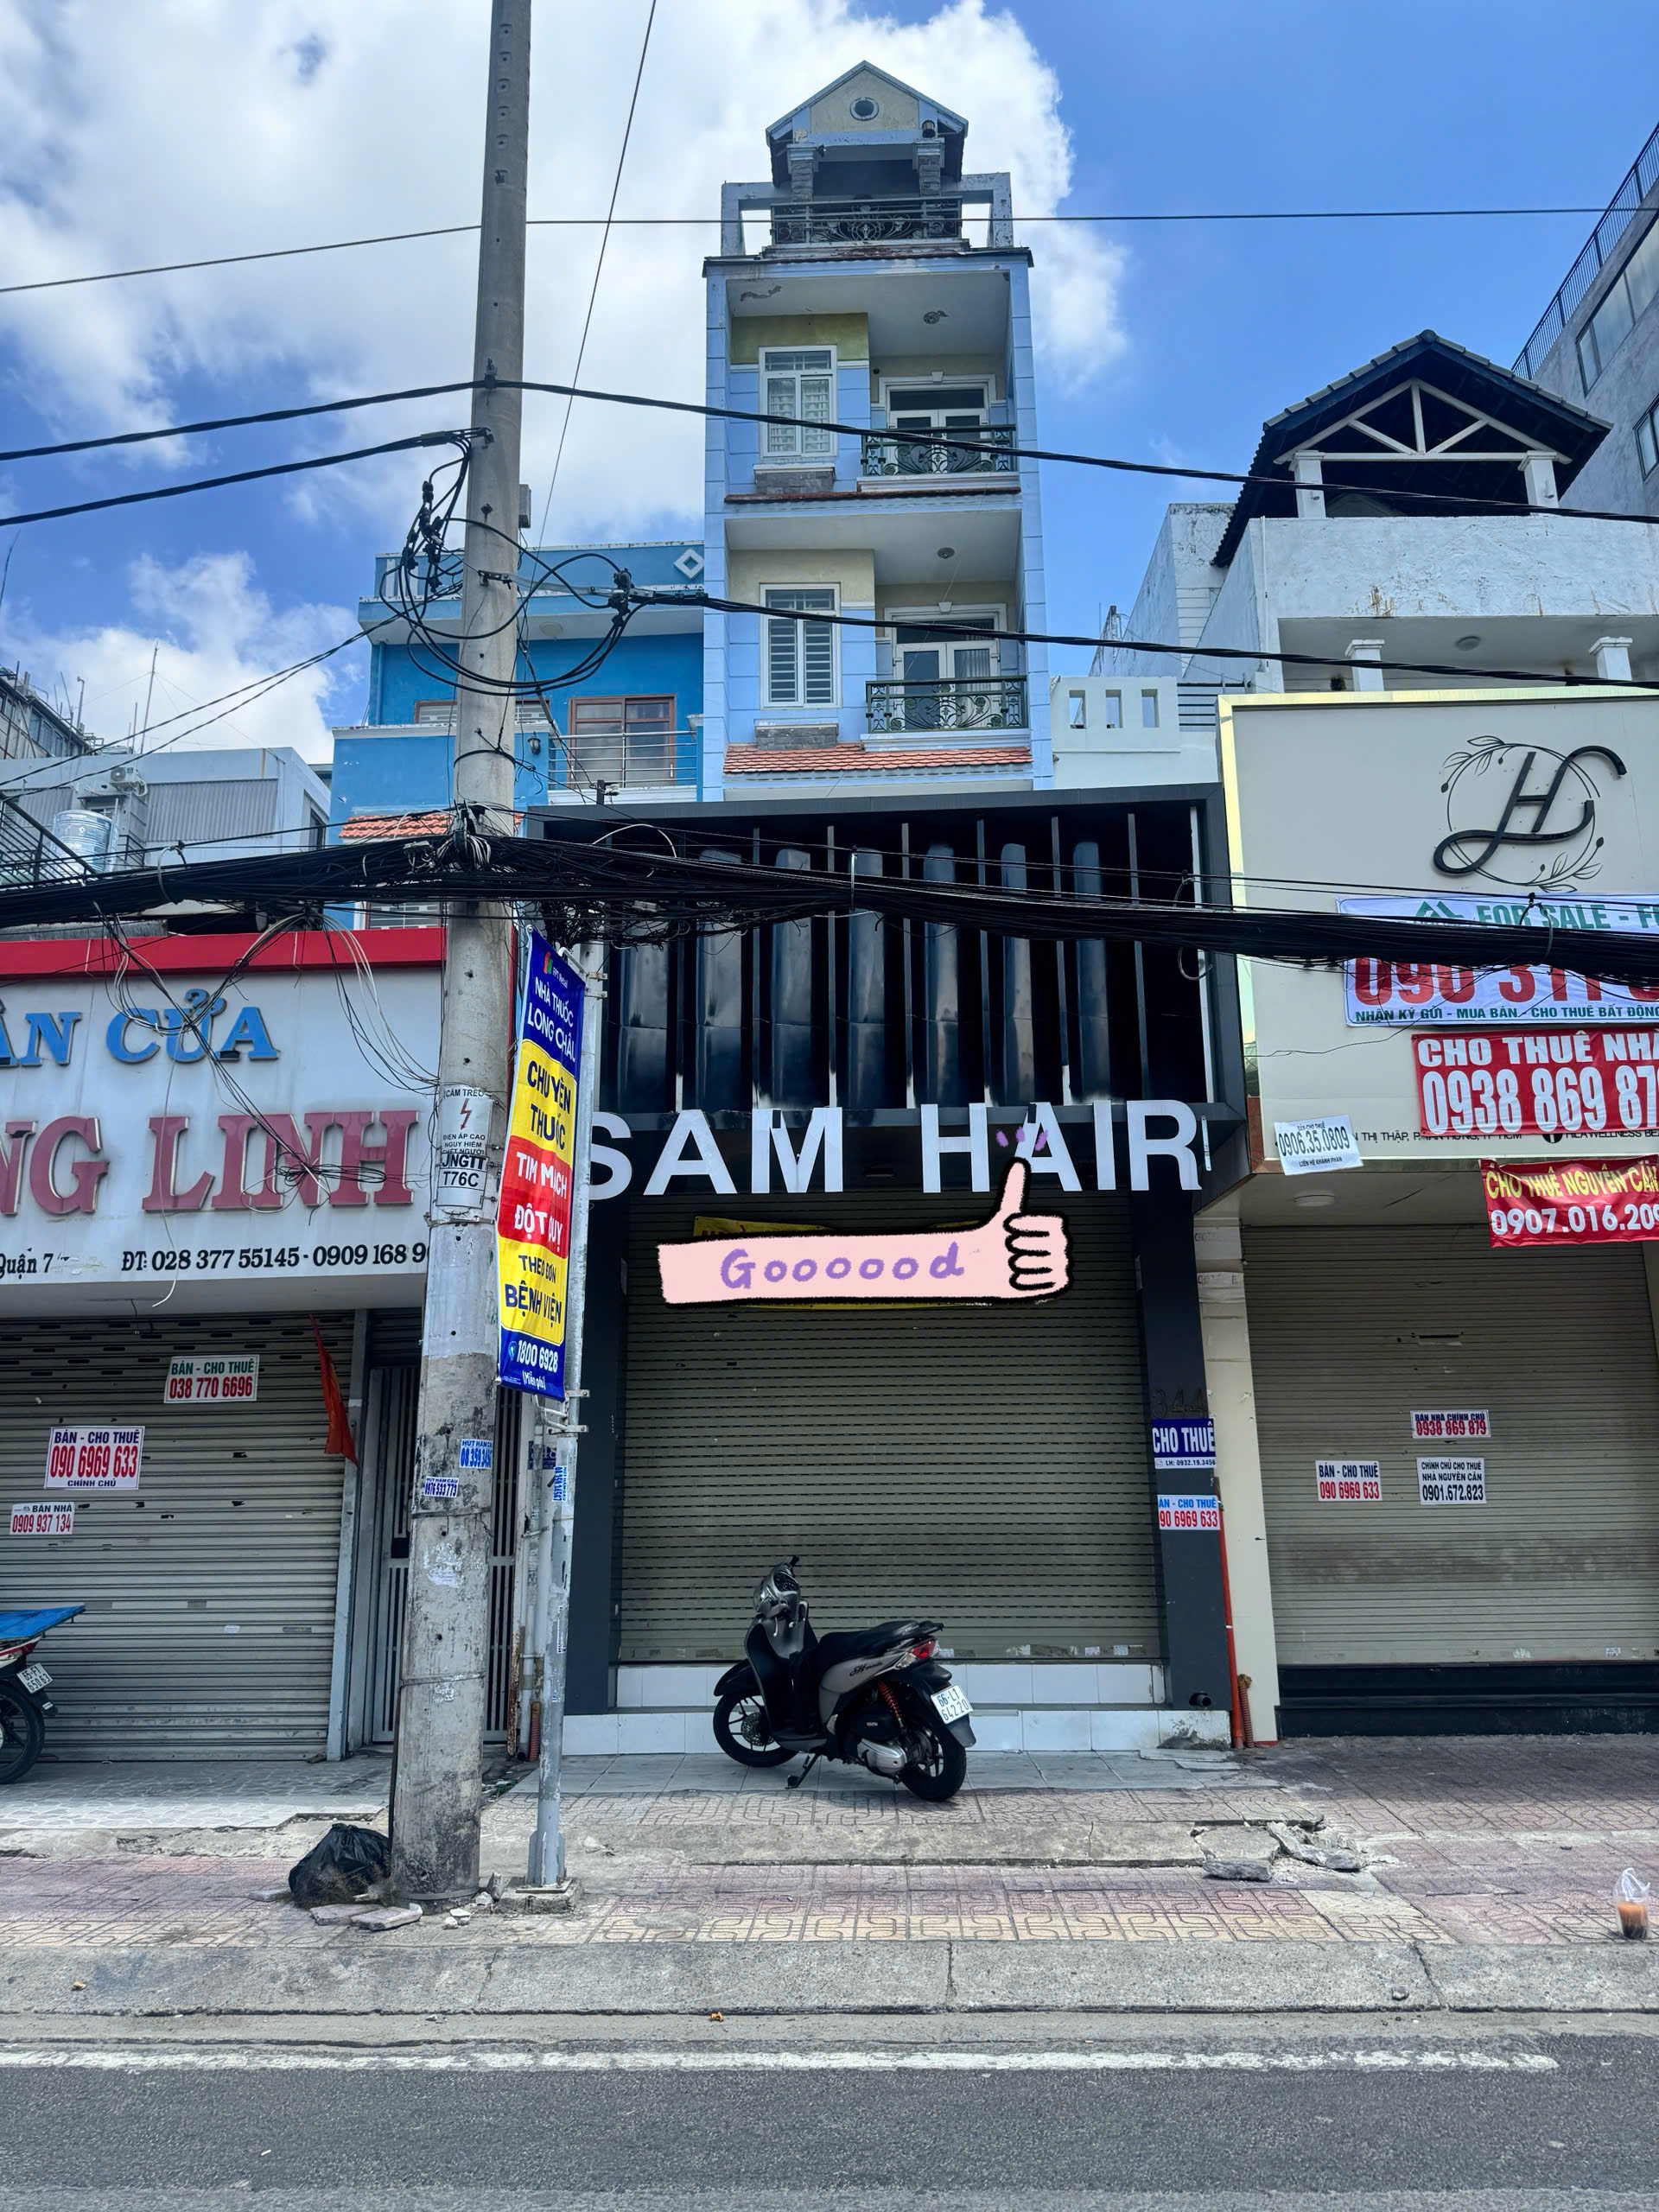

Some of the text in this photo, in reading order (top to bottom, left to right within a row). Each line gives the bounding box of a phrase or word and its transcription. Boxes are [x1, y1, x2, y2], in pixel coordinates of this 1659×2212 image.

[1476, 904, 1532, 926] FOR
[1541, 905, 1611, 929] SALE
[1637, 904, 1659, 929] F
[1354, 957, 1475, 1005] 090
[535, 976, 574, 1028] NHÀ THUỐC
[1355, 1007, 1395, 1023] NHẬN
[1398, 1004, 1415, 1020] KÝ
[1456, 1007, 1486, 1020] MUA
[1490, 1005, 1518, 1019] BÁN
[1531, 1007, 1558, 1018] CHO
[1560, 1005, 1594, 1018] THUÊ
[1598, 1003, 1623, 1017] BẤT
[105, 988, 279, 1065] CỬA
[527, 1002, 555, 1042] LONG
[1417, 1037, 1492, 1068] CHO
[1502, 1030, 1593, 1065] THUÊ
[527, 1060, 571, 1115] CHUYÊN
[1421, 1065, 1659, 1135] 0938 869 87
[458, 1132, 468, 1141] ÁP
[530, 1103, 566, 1151] THUỐC
[1361, 1131, 1377, 1143] THỊ
[588, 1099, 1202, 1200] SAM HAIR
[1278, 1125, 1351, 1157] 0906.35.0809
[142, 1109, 420, 1212] LINH
[516, 1151, 538, 1185] TIM
[443, 1171, 480, 1188] T76C
[1485, 1170, 1522, 1199] CHO
[1522, 1166, 1564, 1198] THUÊ
[1560, 1162, 1629, 1197] NGUYÊN
[514, 1202, 548, 1240] ĐỘT
[43, 1253, 54, 1274] 7
[151, 1249, 191, 1271] 028
[196, 1249, 234, 1269] 377
[238, 1247, 300, 1268] 55145
[313, 1245, 368, 1267] 0909
[372, 1244, 408, 1265] 168
[412, 1242, 430, 1263] 9
[518, 1255, 545, 1274] THEO
[505, 1280, 563, 1328] BỆNH VIỆN
[172, 1360, 194, 1376] BÁN
[203, 1361, 226, 1375] CHO
[228, 1357, 254, 1373] THUÊ
[517, 1339, 558, 1374] 1800 6928
[168, 1376, 253, 1399] 038 770 6696
[1414, 1413, 1429, 1421] BÁN
[1447, 1412, 1469, 1421] CHÍNH
[1415, 1420, 1486, 1436] 0938 869 879
[54, 1428, 77, 1444] BÁN
[88, 1430, 111, 1444] CHO
[112, 1428, 140, 1444] THUÊ
[1152, 1421, 1216, 1453] CHO THUÊ
[49, 1445, 139, 1478] 090 6969 633
[1319, 1462, 1378, 1478] BÁN CHO THUÊ
[1421, 1458, 1482, 1470] CHÍNH CHỦ CHO THUÊ
[67, 1477, 117, 1488] CHÍNH CHỦ
[1422, 1471, 1482, 1481] NHÀ NGUYÊN CĂN
[1319, 1481, 1380, 1499] 090 6969 633
[1422, 1484, 1484, 1502] 0901.672.823
[32, 1502, 73, 1513] BÁN NHÀ
[1178, 1498, 1194, 1509] CHO
[1196, 1497, 1217, 1509] THUÊ
[12, 1514, 72, 1533] 0909 937 134
[1174, 1510, 1198, 1528] 6969
[1200, 1510, 1218, 1528] 633
[937, 1688, 960, 1707] 66-L1
